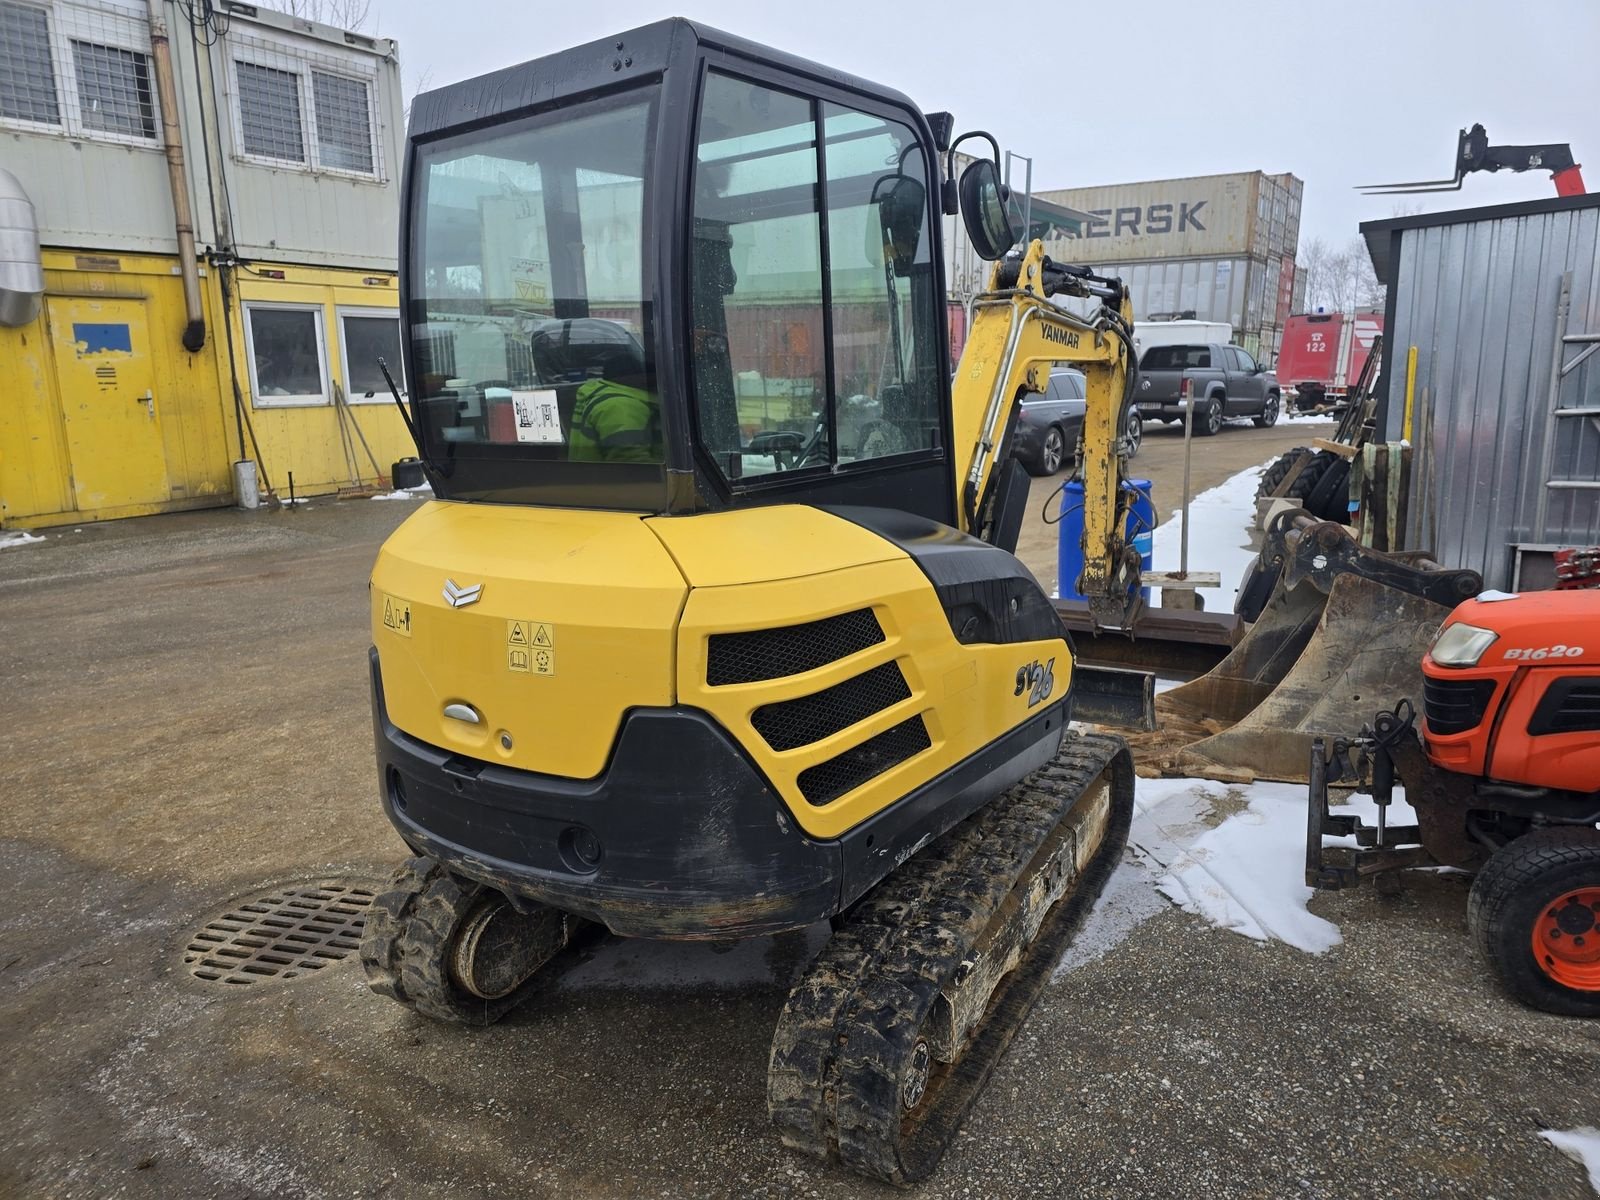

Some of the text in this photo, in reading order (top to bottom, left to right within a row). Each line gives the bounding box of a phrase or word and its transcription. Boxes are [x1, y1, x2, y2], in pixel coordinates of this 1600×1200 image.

[1055, 201, 1208, 240] ERSK
[1041, 322, 1080, 349] YANMAR
[1306, 342, 1326, 352] 122
[1503, 645, 1584, 660] B1620
